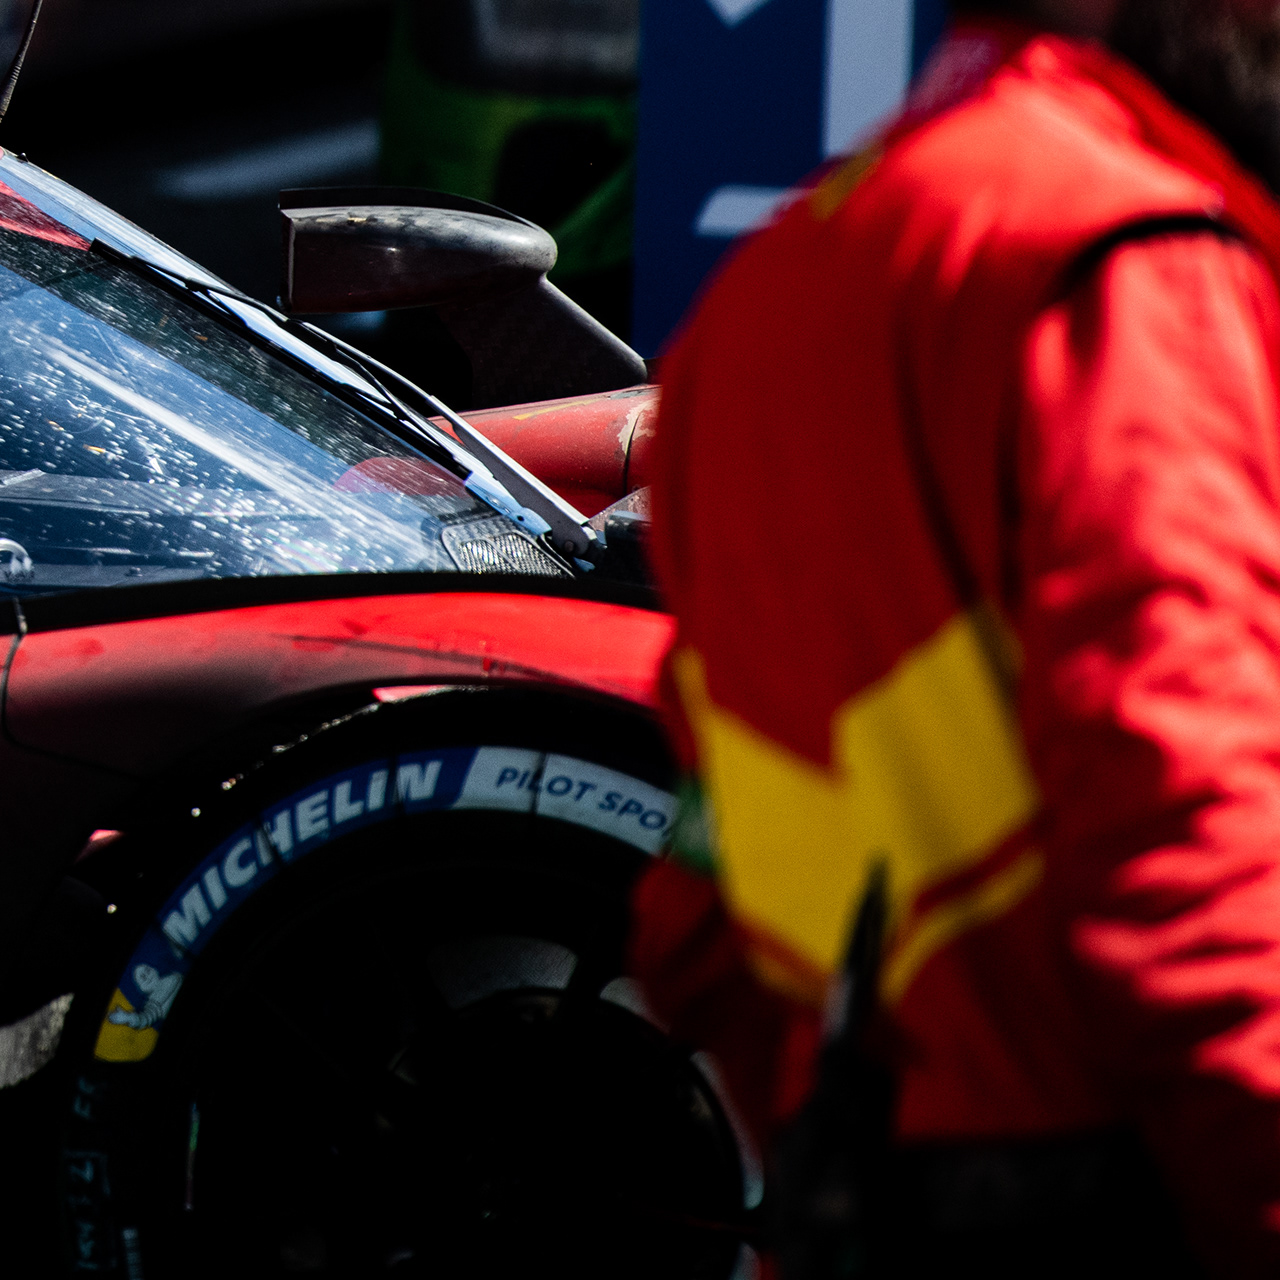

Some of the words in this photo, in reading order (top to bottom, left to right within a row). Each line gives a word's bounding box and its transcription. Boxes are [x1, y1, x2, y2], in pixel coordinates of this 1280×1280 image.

[162, 760, 444, 958] MICHELIN
[496, 767, 597, 803] PILOT
[597, 790, 670, 838] SPO
